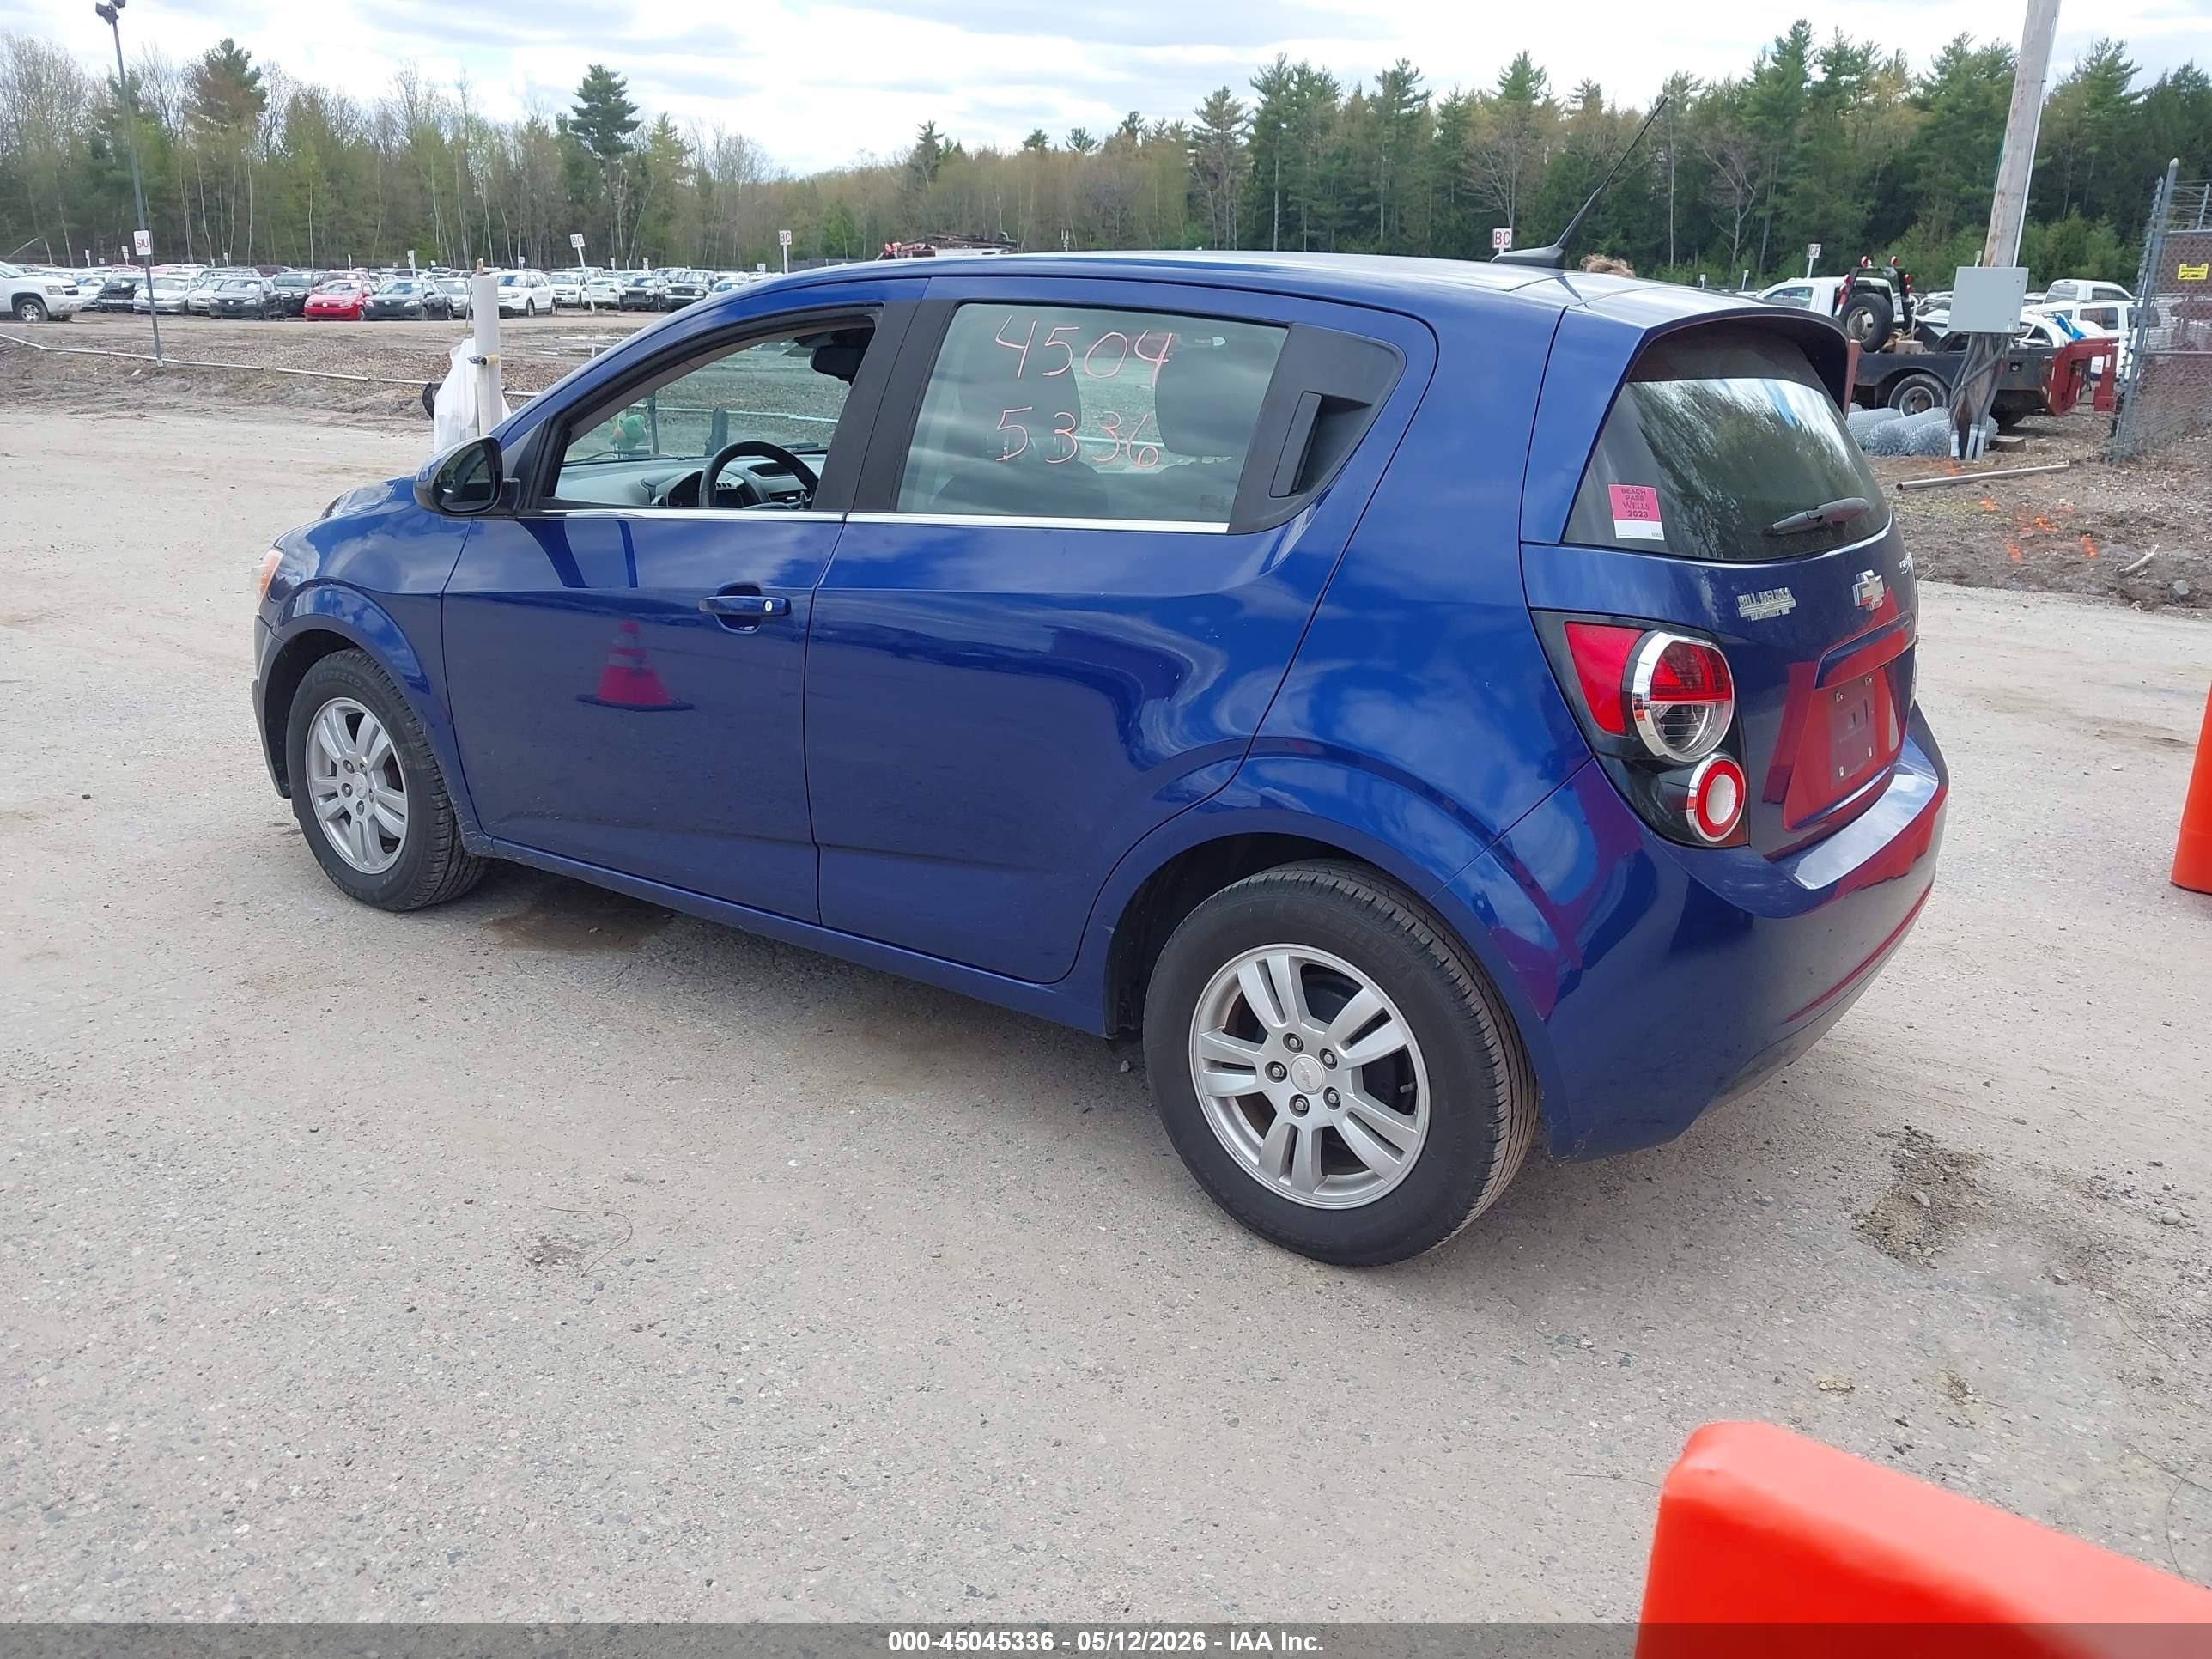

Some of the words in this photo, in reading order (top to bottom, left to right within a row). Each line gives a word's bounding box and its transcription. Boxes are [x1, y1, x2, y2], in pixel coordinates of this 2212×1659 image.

[571, 235, 584, 246] BC
[781, 232, 791, 243] BC
[1495, 231, 1511, 246] BC
[137, 238, 149, 249] SIU
[995, 315, 1173, 386] 4504
[995, 406, 1159, 467] 5336
[1623, 501, 1650, 511] WELLS
[1627, 510, 1649, 519] 2023
